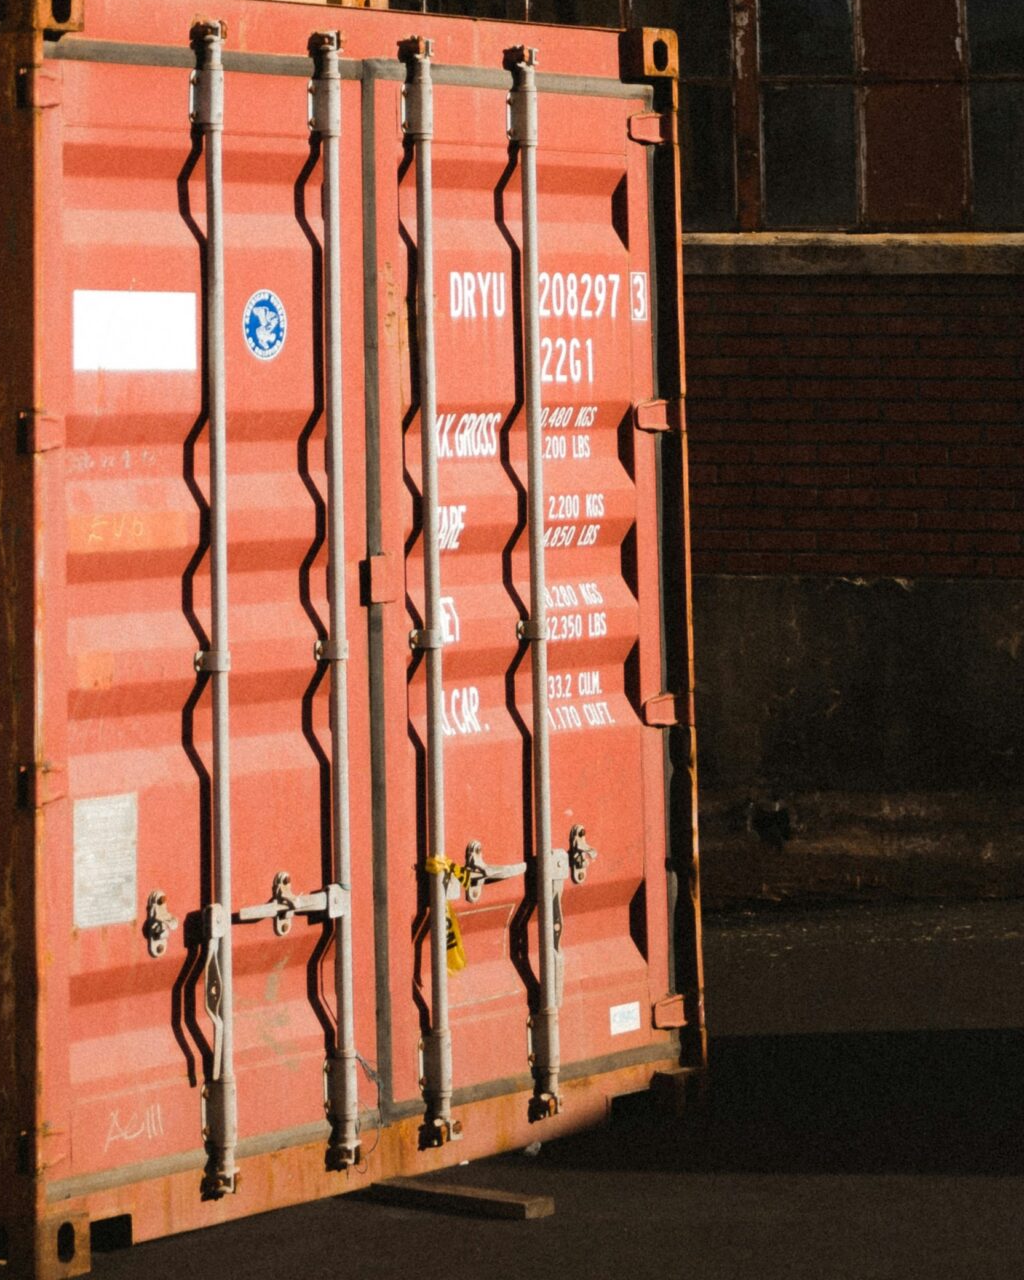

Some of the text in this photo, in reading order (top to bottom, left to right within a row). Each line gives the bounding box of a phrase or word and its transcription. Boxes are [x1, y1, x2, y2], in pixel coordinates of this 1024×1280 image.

[450, 271, 647, 320] DRYU 208297 3
[540, 337, 594, 383] 22G1
[540, 406, 598, 428] 0.480 KGS
[455, 412, 502, 458] GROSS
[572, 434, 591, 459] LBS
[548, 492, 605, 519] 2.200 KGS
[576, 523, 601, 547] LBS
[543, 582, 604, 608] 8.280 KGS
[588, 611, 607, 637] LBS
